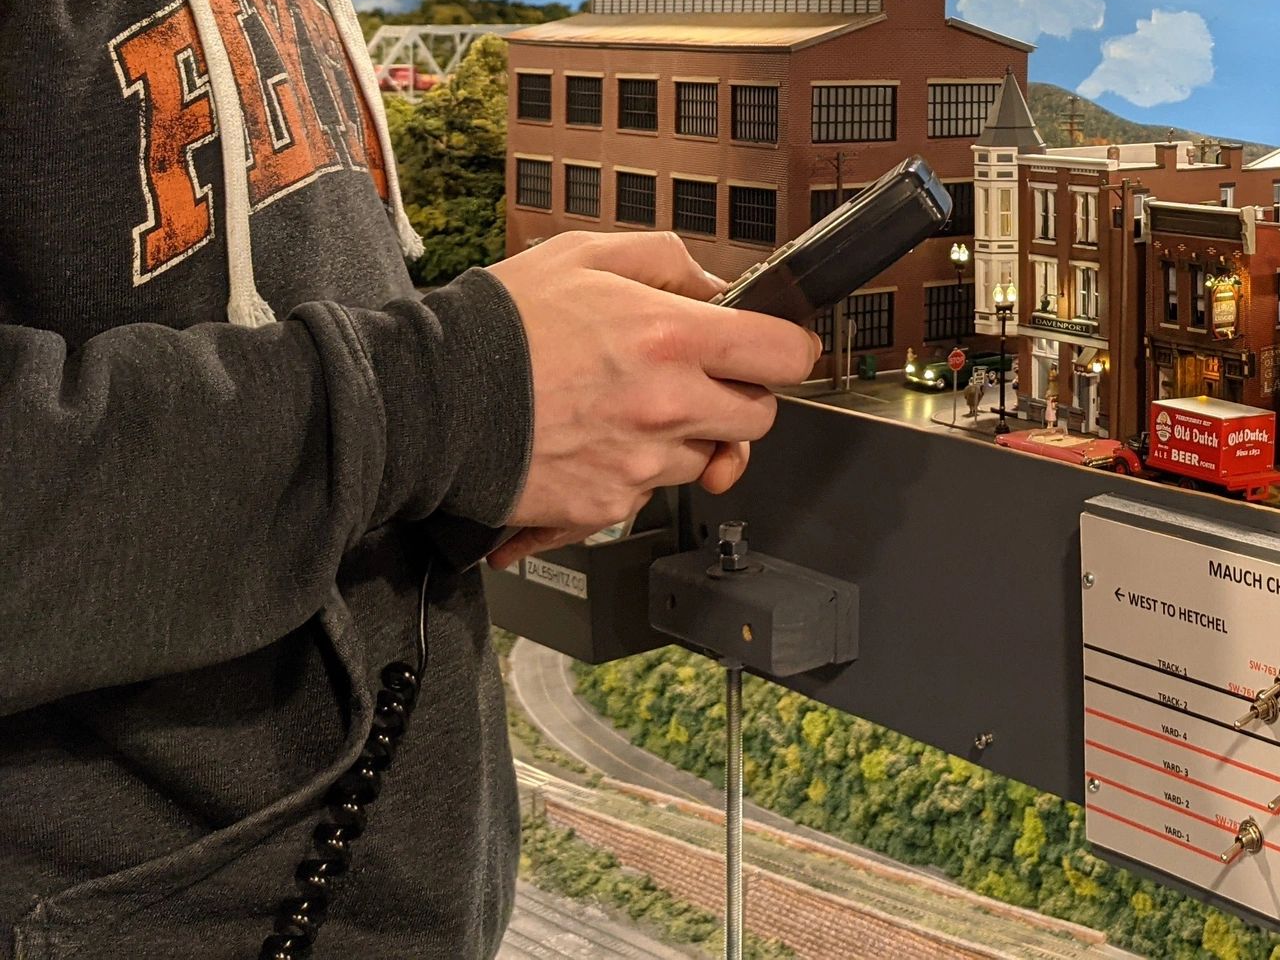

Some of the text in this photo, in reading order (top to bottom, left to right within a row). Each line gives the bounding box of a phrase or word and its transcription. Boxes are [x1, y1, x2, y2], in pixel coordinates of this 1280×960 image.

[1035, 318, 1087, 332] DAVENPORT
[949, 355, 965, 365] STOP
[1174, 424, 1219, 448] Old Dutch
[1228, 428, 1269, 446] Old Dutch
[1154, 449, 1168, 459] ALE
[1171, 448, 1199, 467] BEER
[1208, 560, 1262, 590] MAUCH
[1128, 591, 1228, 634] WEST TO HETCHEL
[1249, 660, 1277, 676] SW-763
[1182, 732, 1188, 741] 4
[1184, 768, 1189, 777] 3
[1185, 799, 1190, 808] 2
[1186, 833, 1190, 842] 1
